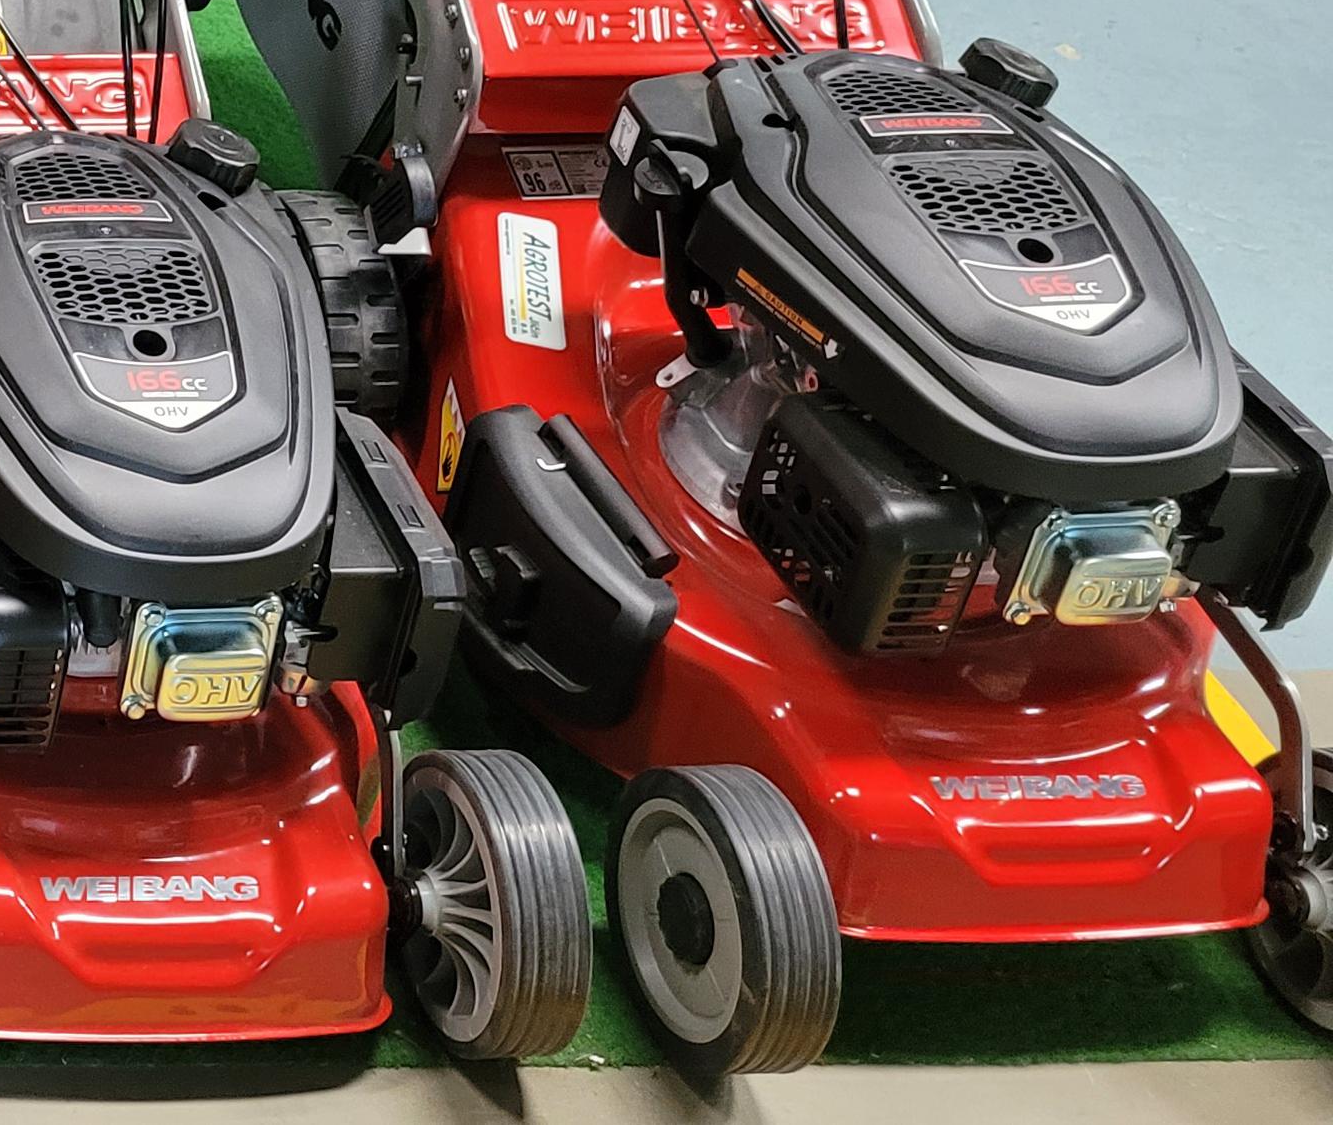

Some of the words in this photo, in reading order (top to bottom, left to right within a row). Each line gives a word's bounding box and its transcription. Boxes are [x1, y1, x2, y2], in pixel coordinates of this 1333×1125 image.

[879, 117, 983, 131] WEIBANG
[523, 173, 547, 193] 96
[523, 232, 552, 322] AGROTEST
[1018, 275, 1103, 297] 166cc
[765, 292, 803, 325] CAUTION
[1056, 309, 1091, 321] OHV
[126, 370, 208, 392] 166cc
[153, 405, 189, 417] OHV
[1072, 576, 1163, 610] OHV
[170, 674, 261, 705] OHV
[928, 775, 1148, 801] WEIBANG
[40, 876, 259, 902] WEIBANG
